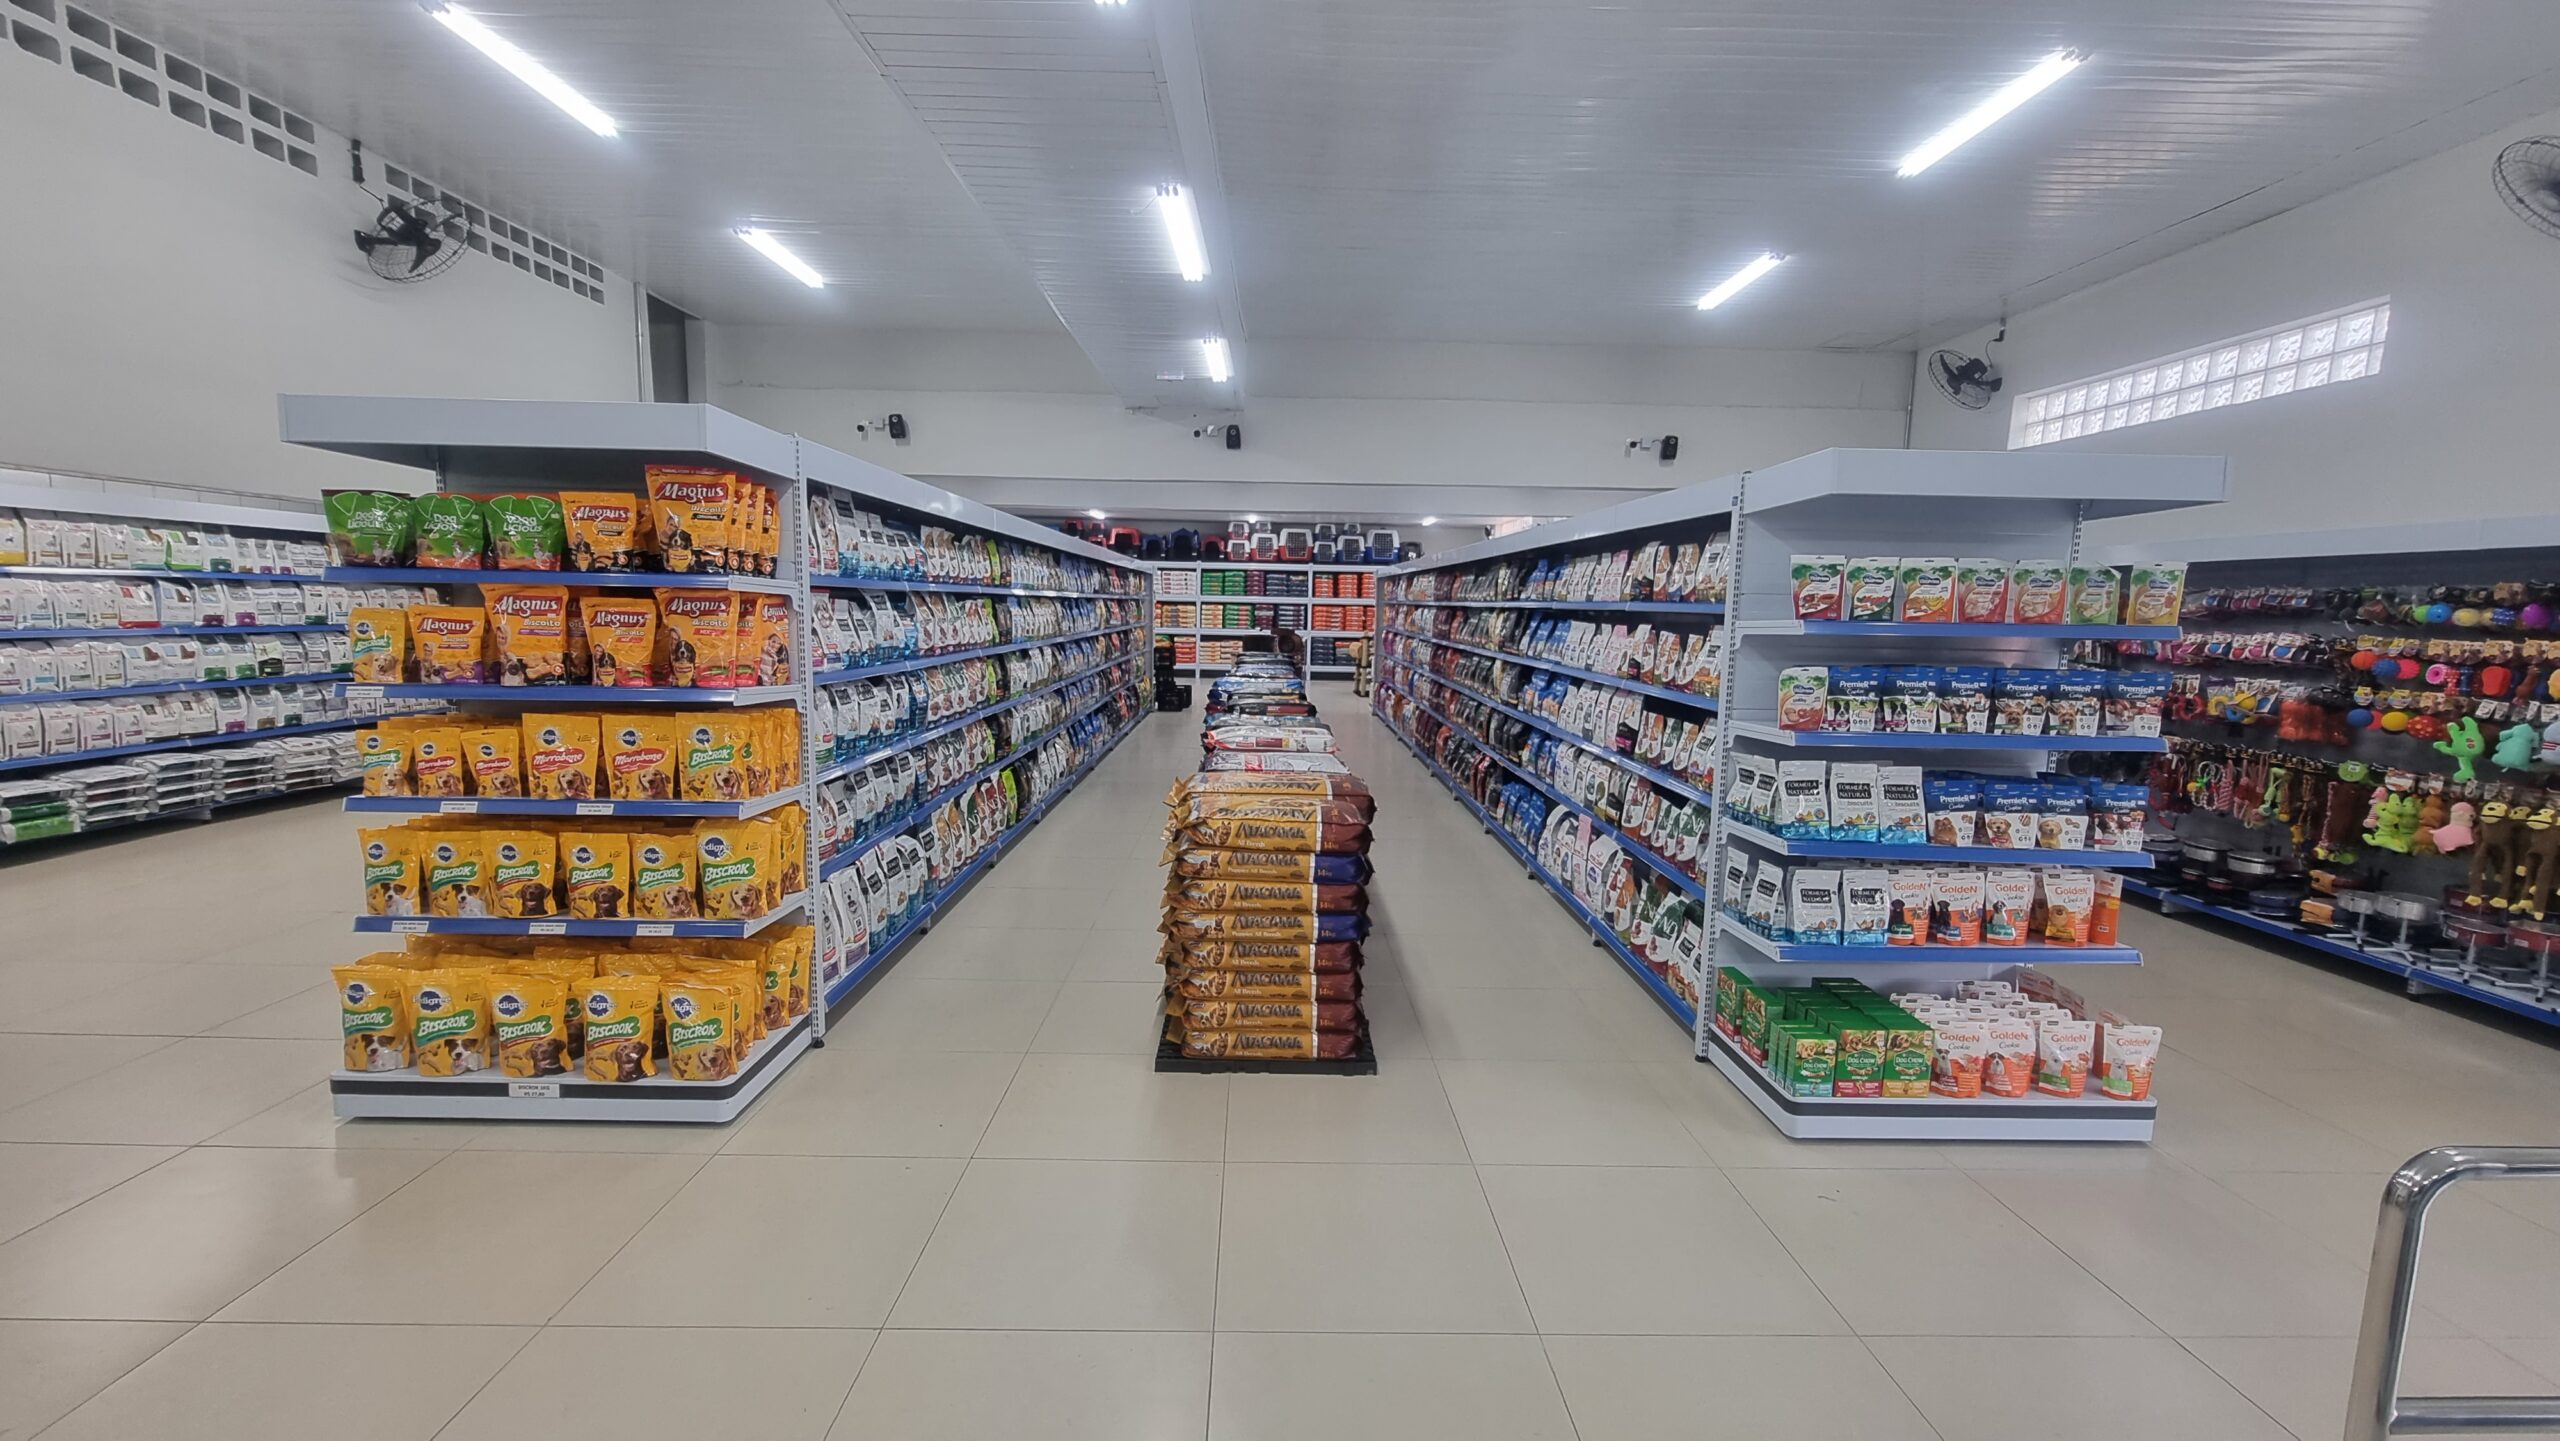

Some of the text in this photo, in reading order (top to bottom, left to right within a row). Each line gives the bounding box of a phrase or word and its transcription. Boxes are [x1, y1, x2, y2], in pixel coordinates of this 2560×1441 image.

[656, 483, 724, 503] Magnus
[573, 506, 627, 522] Magnus
[497, 595, 558, 617] Magnus
[667, 597, 727, 618] Magnus
[418, 618, 472, 635] Magnus
[590, 611, 647, 628] Magnus
[533, 752, 583, 766] Marrobone
[614, 751, 664, 766] Marrobone
[1236, 821, 1306, 839] ATACAMA
[1228, 851, 1299, 867] ATACAMA
[571, 867, 609, 883] BISCROK
[640, 868, 681, 883] BISCROK
[704, 863, 750, 882] BISCROK
[1231, 884, 1303, 900] ATACAMA
[1231, 913, 1305, 929] ATACAMA
[1229, 941, 1300, 958] ATACAMA
[1231, 970, 1302, 987] ATACAMA
[1232, 1001, 1303, 1018] ATACAMA
[343, 1012, 386, 1028] BISCROK
[418, 1014, 469, 1036] BISCROK
[499, 1020, 547, 1042] BISCROK
[587, 1021, 634, 1040] BISCROK
[672, 1023, 718, 1042] BISCROK
[1232, 1032, 1303, 1049] ATACAMA
